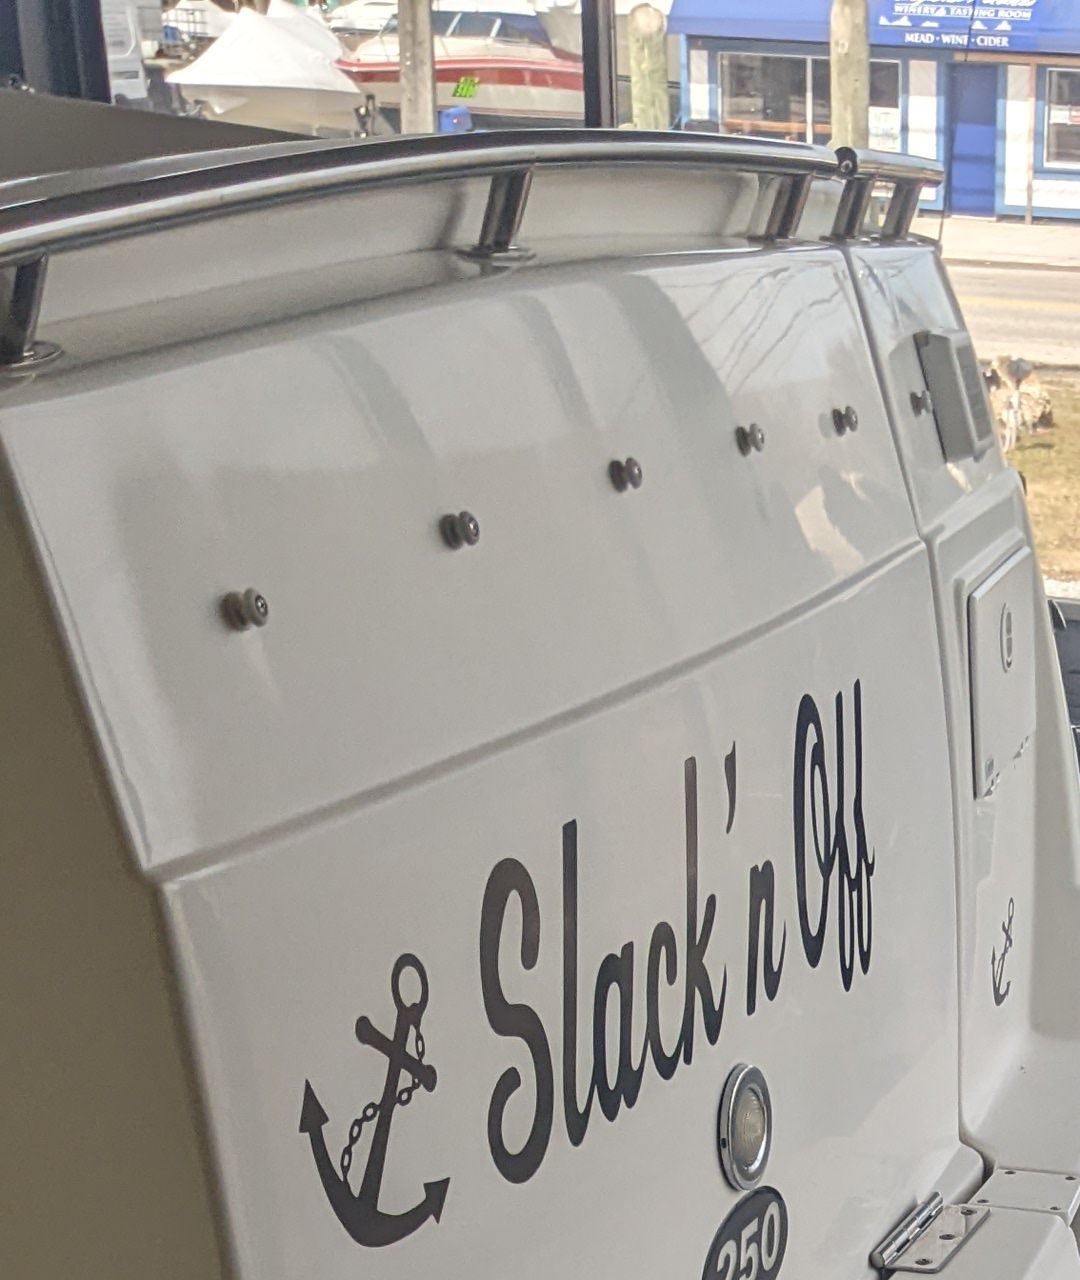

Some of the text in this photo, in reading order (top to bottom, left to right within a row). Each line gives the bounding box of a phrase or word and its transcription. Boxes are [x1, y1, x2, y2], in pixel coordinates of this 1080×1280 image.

[997, 9, 1032, 19] ROOM
[905, 33, 1009, 47] MEAD WINE CIDER
[794, 679, 875, 992] Off
